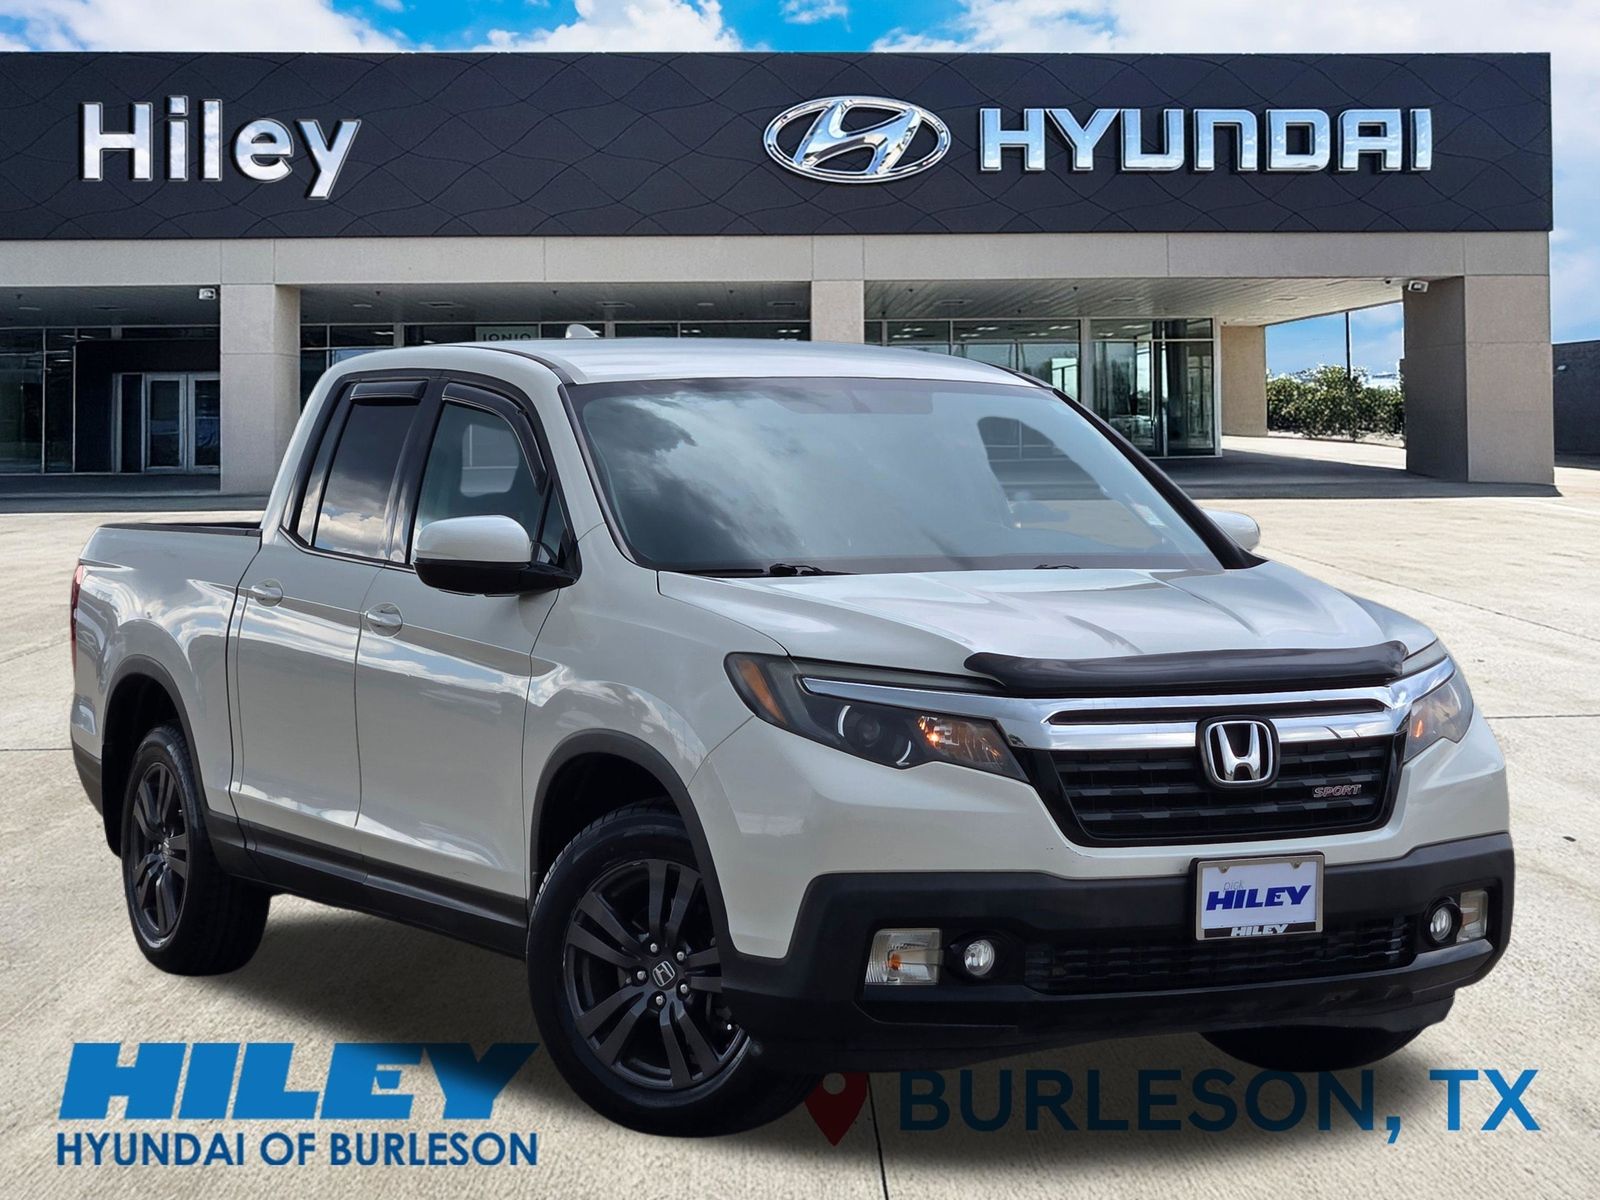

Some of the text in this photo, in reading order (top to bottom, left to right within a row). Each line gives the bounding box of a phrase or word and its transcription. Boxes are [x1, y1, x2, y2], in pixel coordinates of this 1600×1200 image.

[79, 95, 362, 199] Hiley
[979, 108, 1432, 172] HYUNDAI
[1313, 784, 1362, 798] SPORT
[1207, 886, 1311, 911] HILEY
[1230, 924, 1289, 937] HILEY
